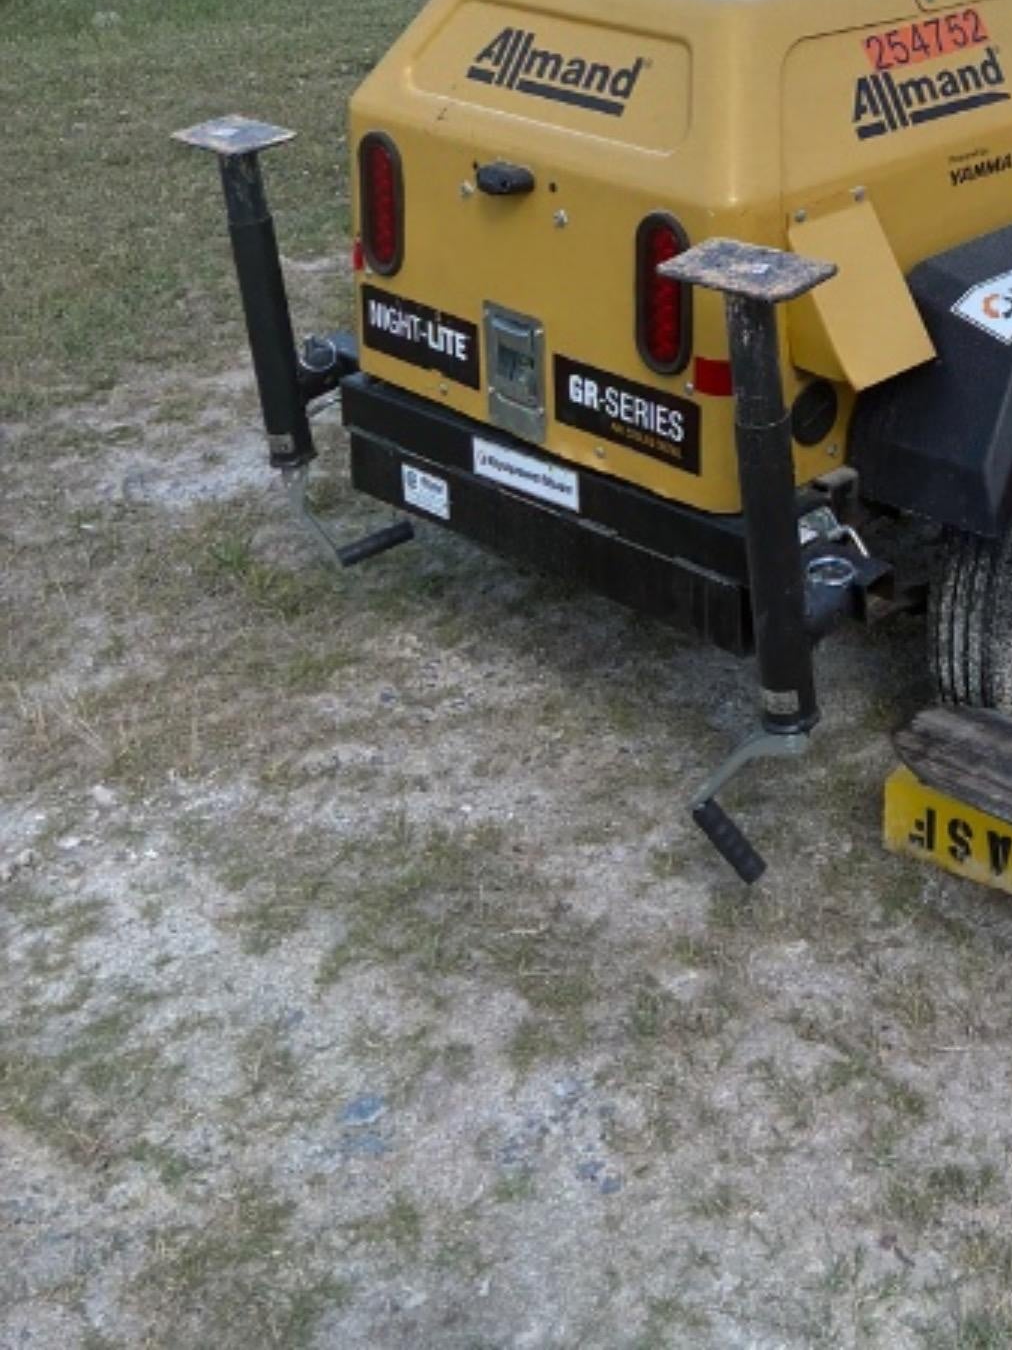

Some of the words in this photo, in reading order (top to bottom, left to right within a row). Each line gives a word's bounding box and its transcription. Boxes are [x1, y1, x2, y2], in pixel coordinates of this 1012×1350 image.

[475, 27, 644, 100] Allmand
[866, 9, 988, 71] 254752
[853, 48, 1005, 131] Allmand
[369, 300, 468, 361] NIGHT-LITE
[569, 374, 685, 442] GR-SERIES
